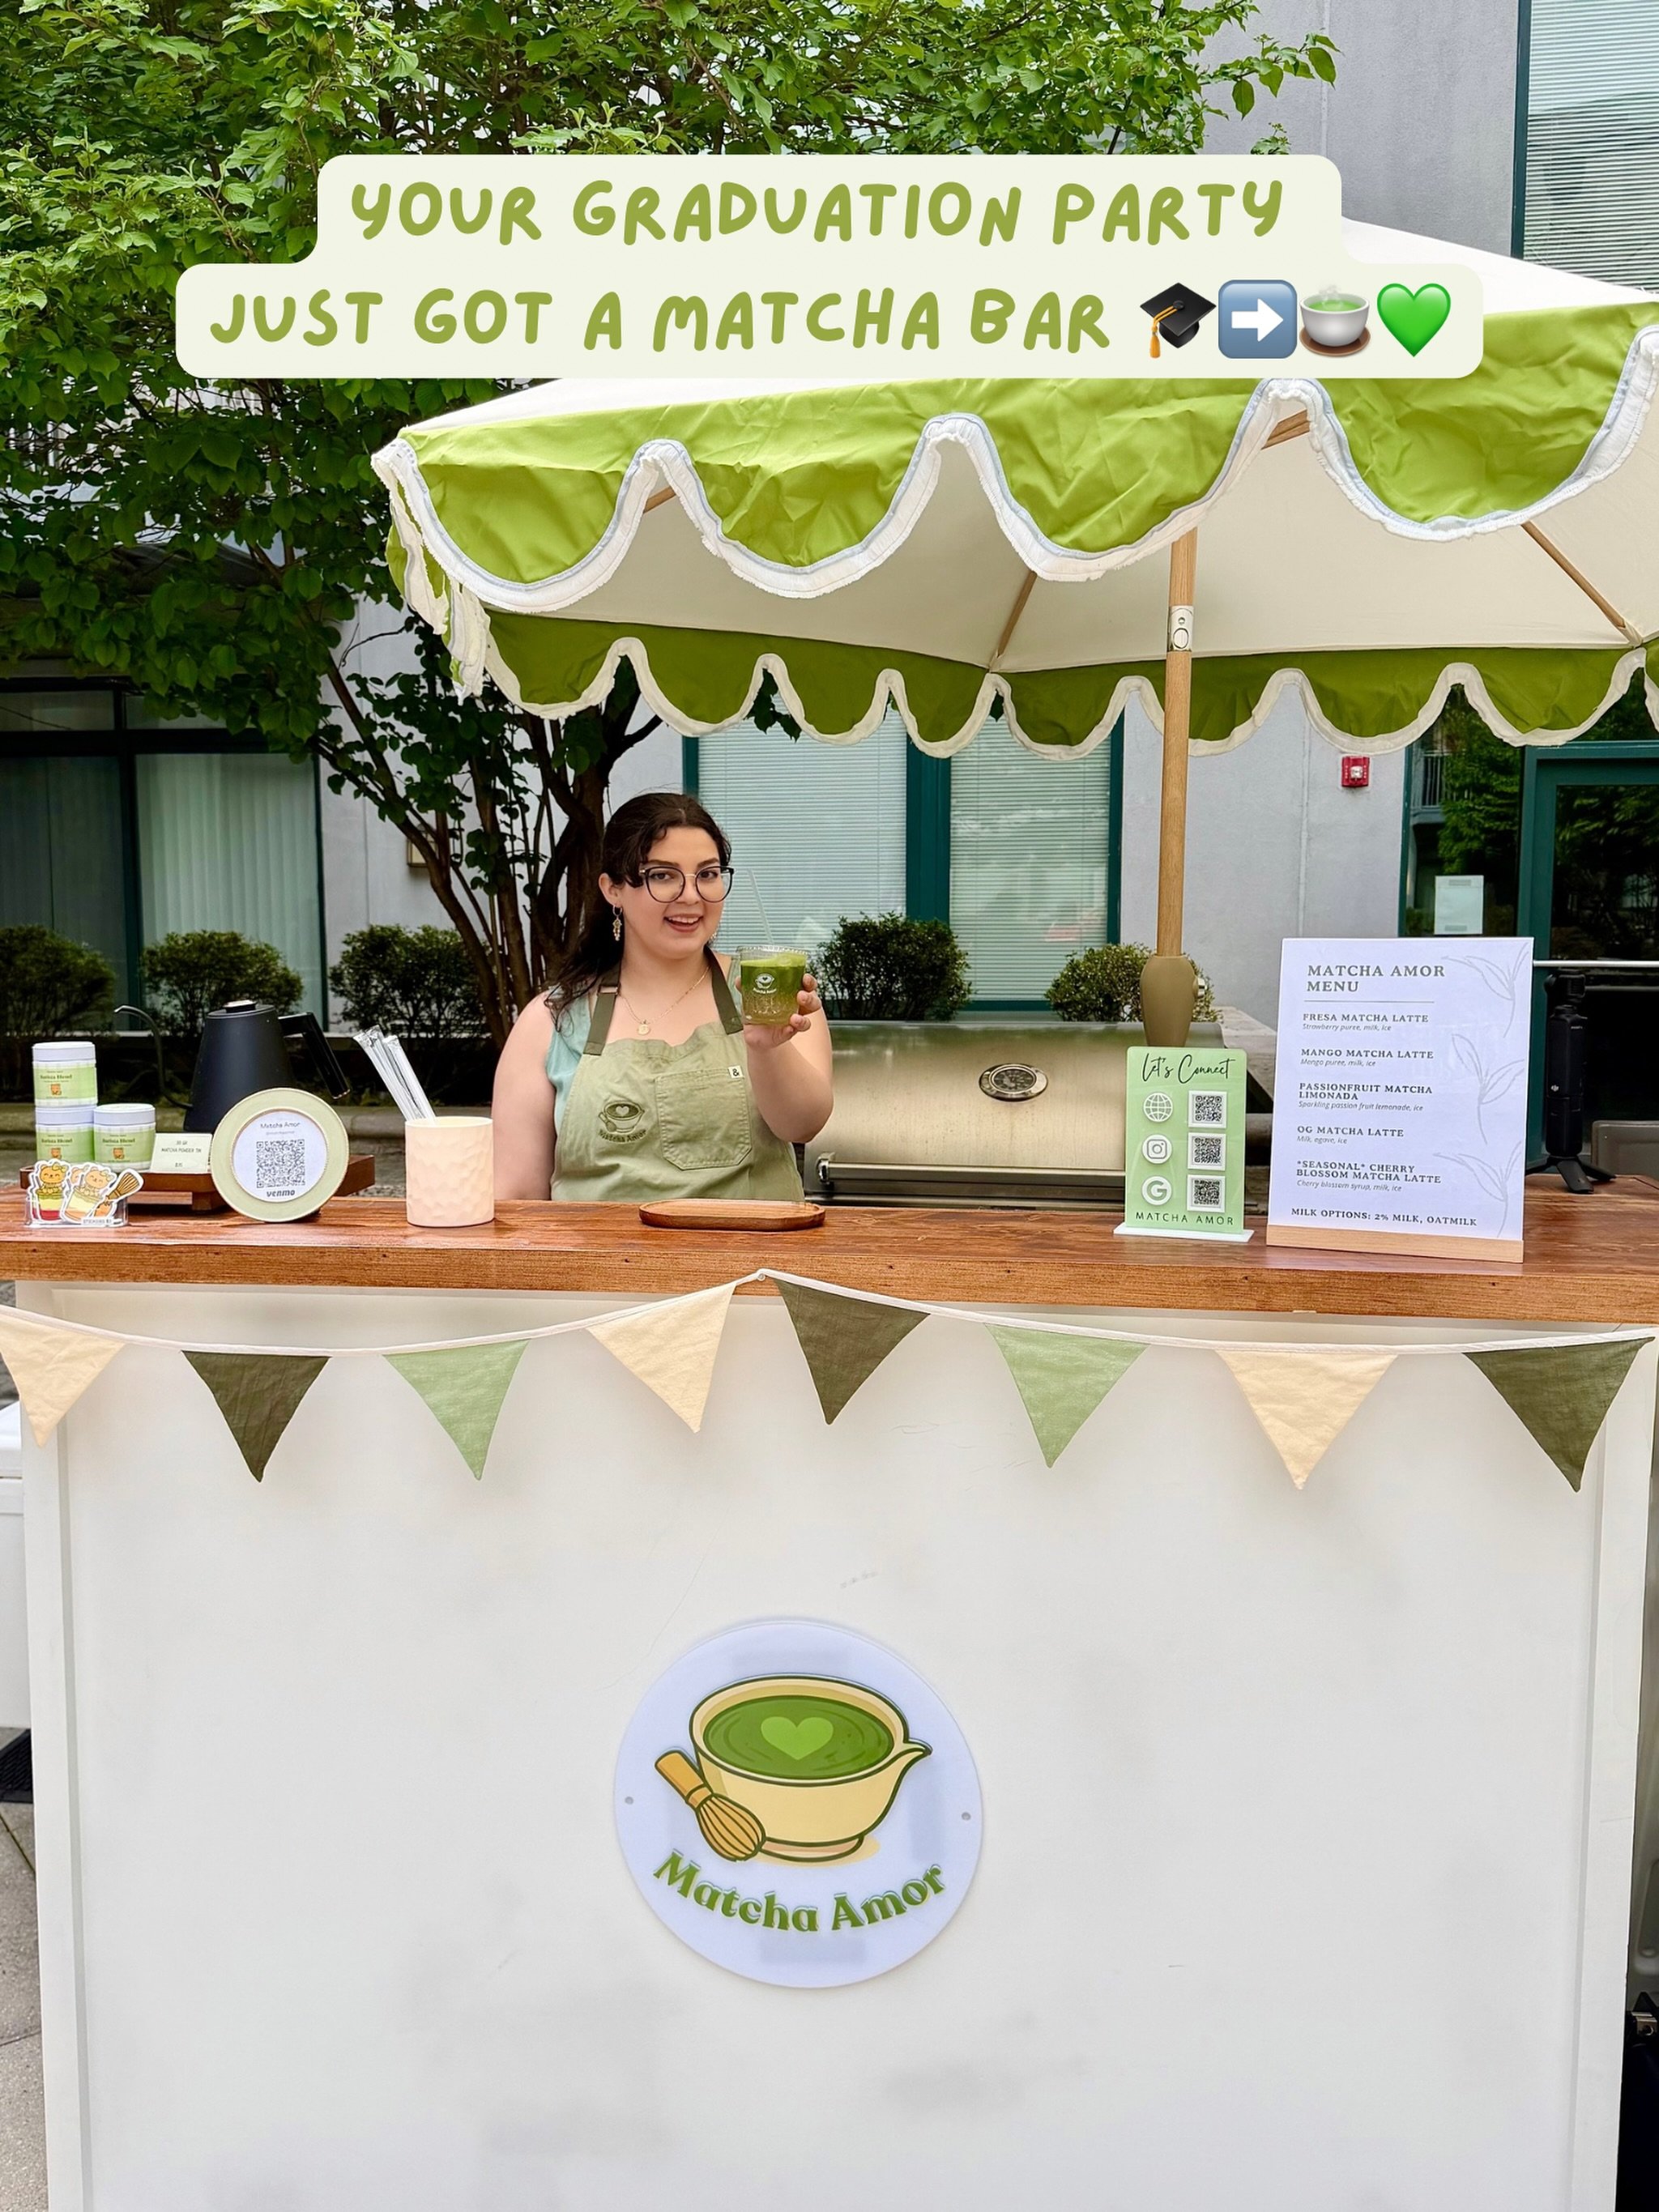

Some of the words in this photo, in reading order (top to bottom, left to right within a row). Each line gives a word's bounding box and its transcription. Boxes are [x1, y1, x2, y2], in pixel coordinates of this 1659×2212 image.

[1308, 965, 1383, 976] MATCHA
[1390, 965, 1445, 976] AMOR
[1307, 981, 1359, 992] MENU
[1142, 1053, 1173, 1082] Let's
[1178, 1054, 1236, 1084] Connect
[1299, 1083, 1381, 1092] PASSIONFRUIT
[1385, 1085, 1432, 1094] MATCHA
[1299, 1092, 1358, 1100] LIMONADA
[1317, 1127, 1363, 1135] MATCHA
[1368, 1128, 1404, 1137] LATTE
[1370, 1164, 1415, 1173] CHERRY
[1296, 1169, 1348, 1178] BLOSSOM
[1353, 1172, 1400, 1181] MATCHA
[1404, 1175, 1441, 1184] LATTE
[1135, 1212, 1188, 1223] MATCHA
[1196, 1216, 1234, 1225] AMOR
[1291, 1208, 1317, 1216] MILK
[1321, 1210, 1371, 1220] OPTIONS:
[1393, 1214, 1423, 1224] MILK,
[1427, 1216, 1477, 1226] OATMILK
[653, 1848, 819, 1933] Matcha
[831, 1863, 946, 1932] Amor
